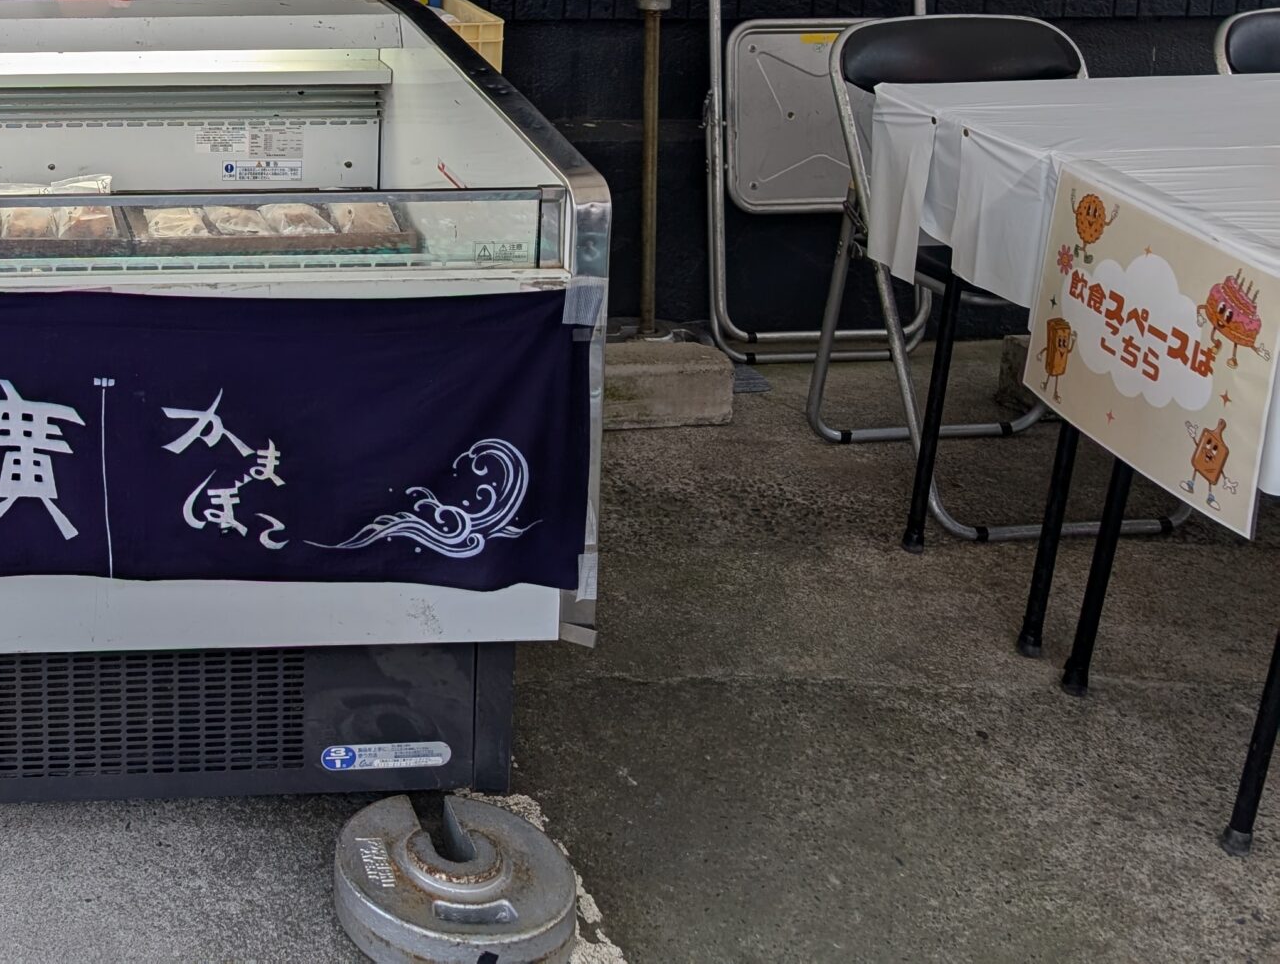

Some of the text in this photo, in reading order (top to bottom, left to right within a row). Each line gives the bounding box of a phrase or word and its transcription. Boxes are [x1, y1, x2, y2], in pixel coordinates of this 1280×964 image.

[1069, 269, 1216, 378] 飲食スペースは
[1100, 321, 1160, 382] こちら
[161, 387, 290, 552] かまぼこ
